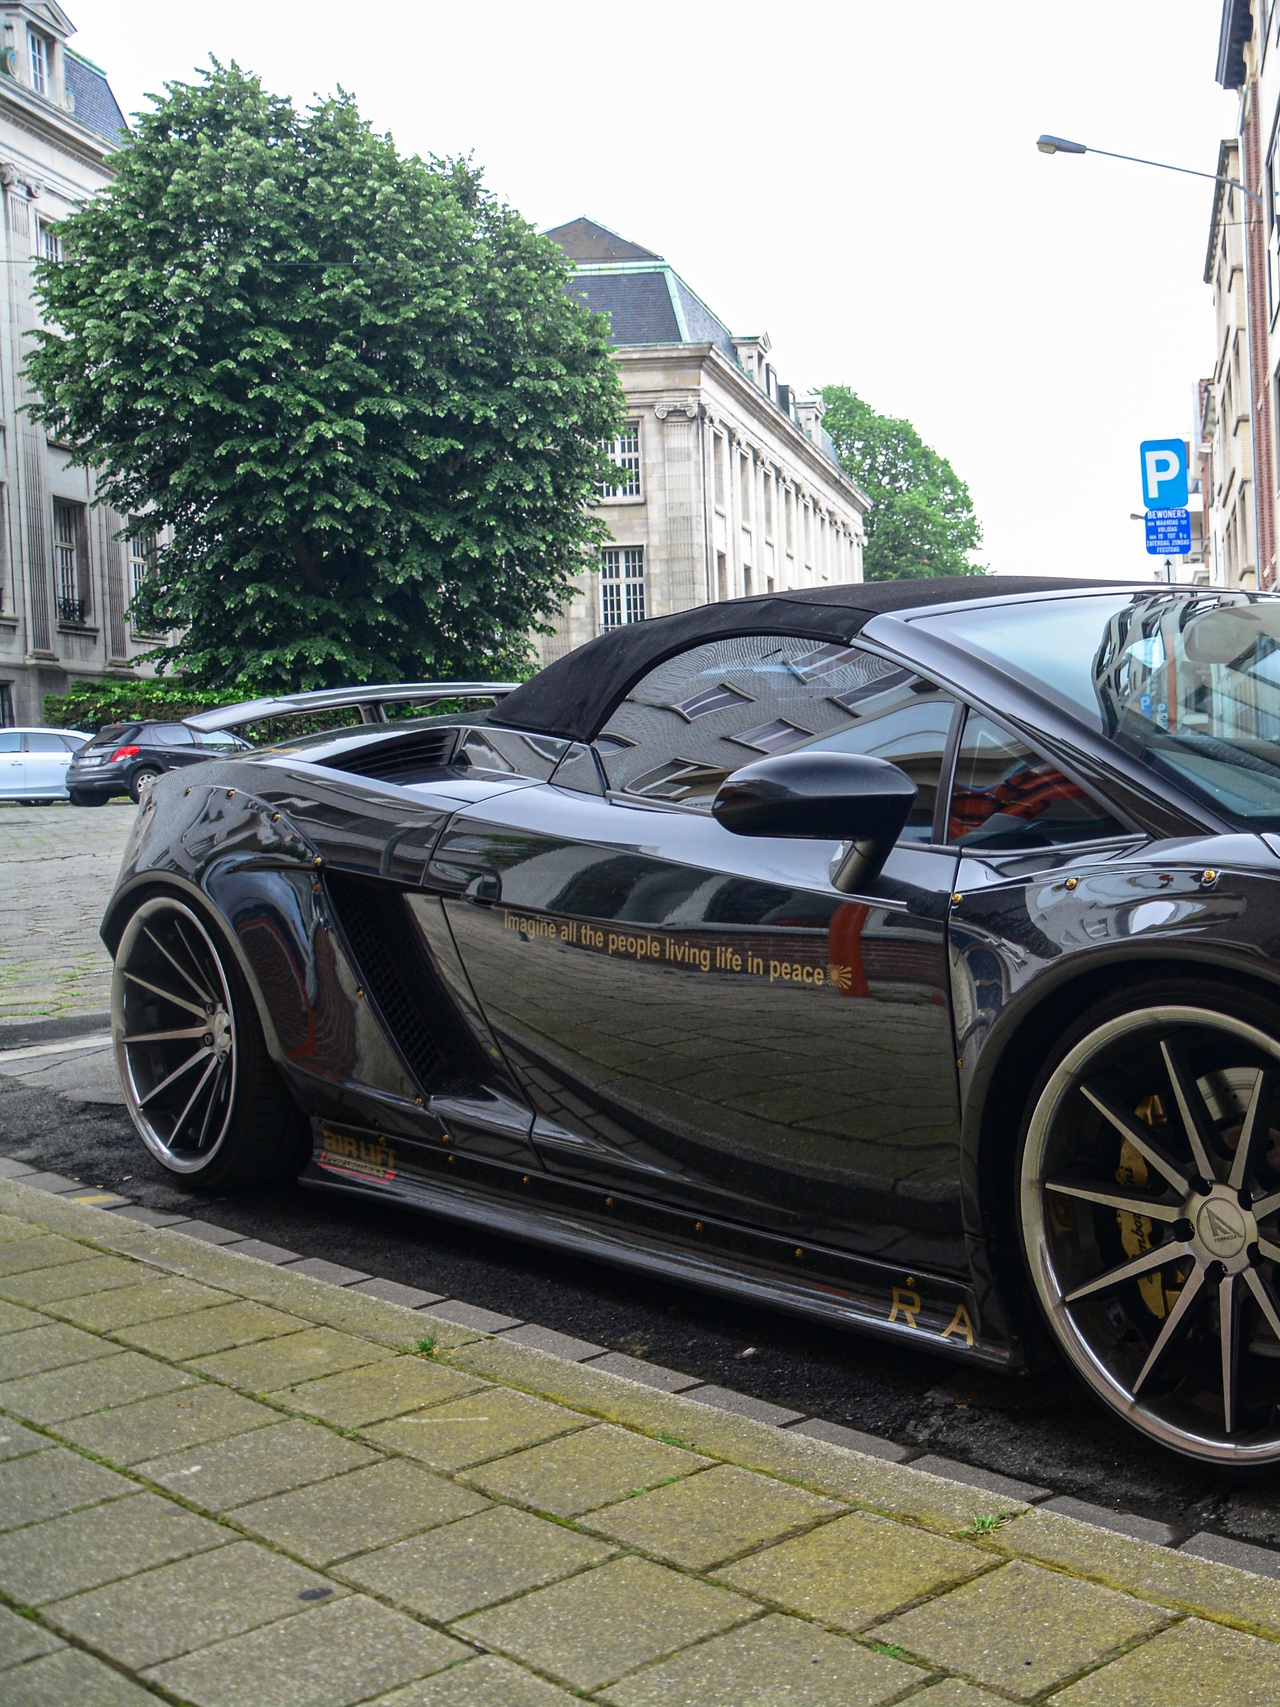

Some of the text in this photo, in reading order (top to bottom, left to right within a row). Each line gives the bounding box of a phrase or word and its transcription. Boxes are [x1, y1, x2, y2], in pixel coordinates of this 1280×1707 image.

[1145, 450, 1180, 498] P
[1147, 509, 1186, 519] BEWONERS
[503, 910, 825, 985] Imagine all the people living life in peace
[360, 1140, 397, 1168] LIFT
[888, 1286, 974, 1346] R A
